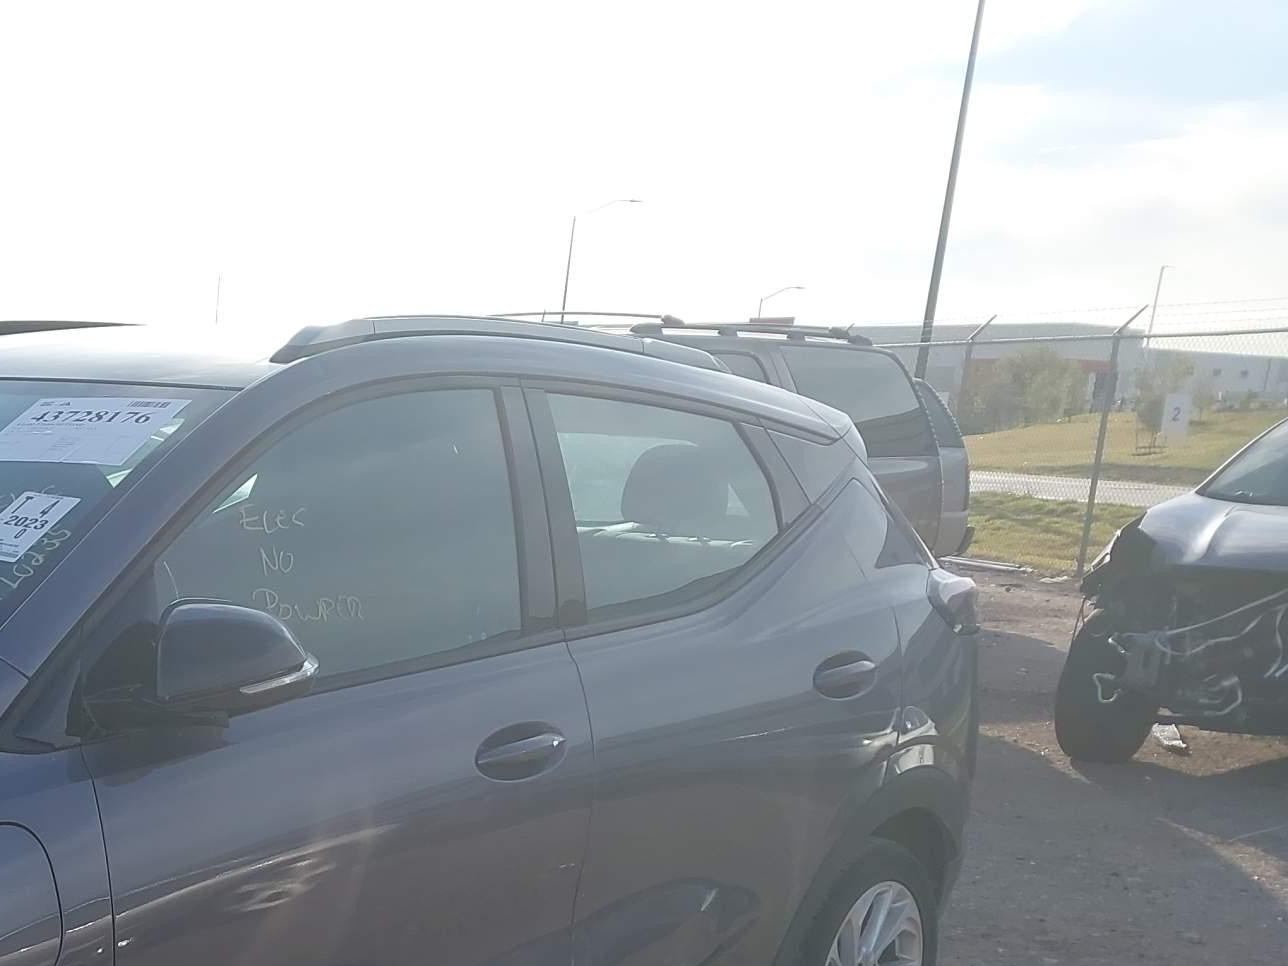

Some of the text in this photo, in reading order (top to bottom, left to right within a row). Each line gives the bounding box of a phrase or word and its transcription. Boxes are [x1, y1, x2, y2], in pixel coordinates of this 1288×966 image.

[31, 409, 152, 424] 43728176
[1171, 406, 1182, 422] 2
[39, 500, 61, 518] 4
[3, 515, 49, 530] 2023
[259, 546, 294, 577] NO
